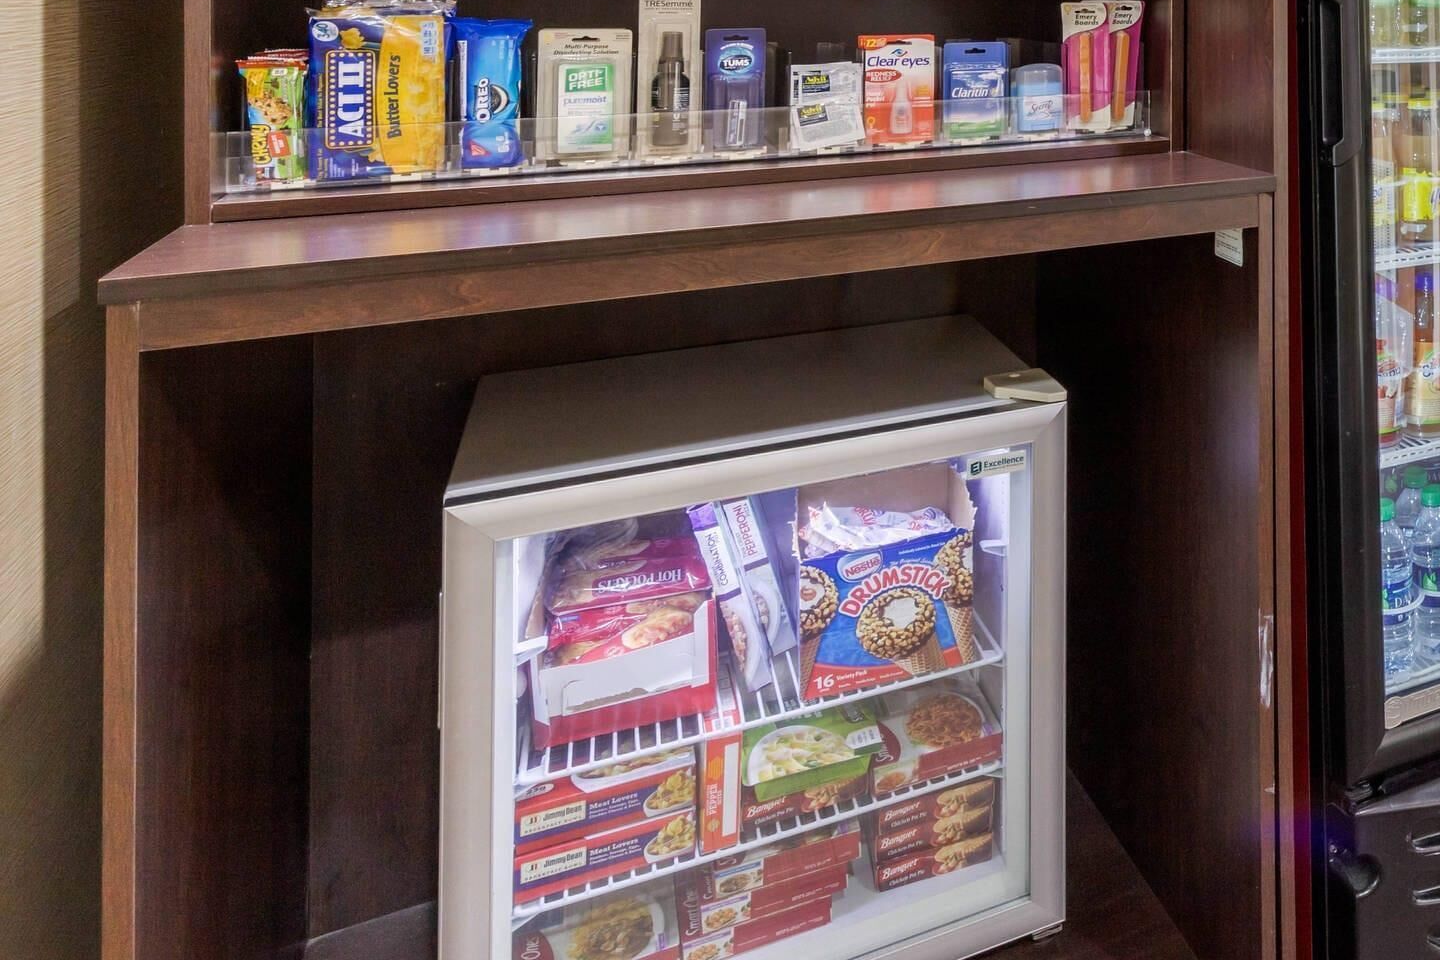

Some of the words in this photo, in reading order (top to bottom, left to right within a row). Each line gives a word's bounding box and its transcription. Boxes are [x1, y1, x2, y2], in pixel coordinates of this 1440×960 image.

[644, 0, 693, 7] TRESemmé
[1075, 13, 1098, 21] Emery
[1113, 12, 1133, 20] Emery
[722, 58, 750, 68] TUMS
[867, 56, 900, 67] Clear
[901, 56, 930, 69] eyes
[337, 60, 365, 88] II
[384, 54, 401, 96] Lovers
[805, 75, 827, 85] Advil
[568, 79, 604, 91] FREE
[951, 87, 989, 98] Claritin
[476, 77, 491, 124] OREO
[1031, 100, 1054, 112] Secret
[337, 91, 365, 138] ACT
[386, 98, 402, 139] Butter
[983, 456, 1024, 469] Excellence
[733, 504, 758, 557] PEPPERONI
[705, 533, 729, 586] COMBINATION
[658, 569, 682, 583] HOT
[840, 566, 951, 617] DRUMSTICK
[814, 673, 835, 691] 16
[836, 672, 855, 682] Variety
[855, 669, 868, 678] Pack
[588, 800, 610, 810] Meat
[611, 792, 639, 805] Lovers
[542, 810, 566, 822] Jimmy
[565, 804, 583, 816] Dean
[589, 846, 611, 857] Meat
[612, 838, 639, 851] Lovers
[543, 856, 566, 869] Jimmy
[566, 851, 583, 862] Dean
